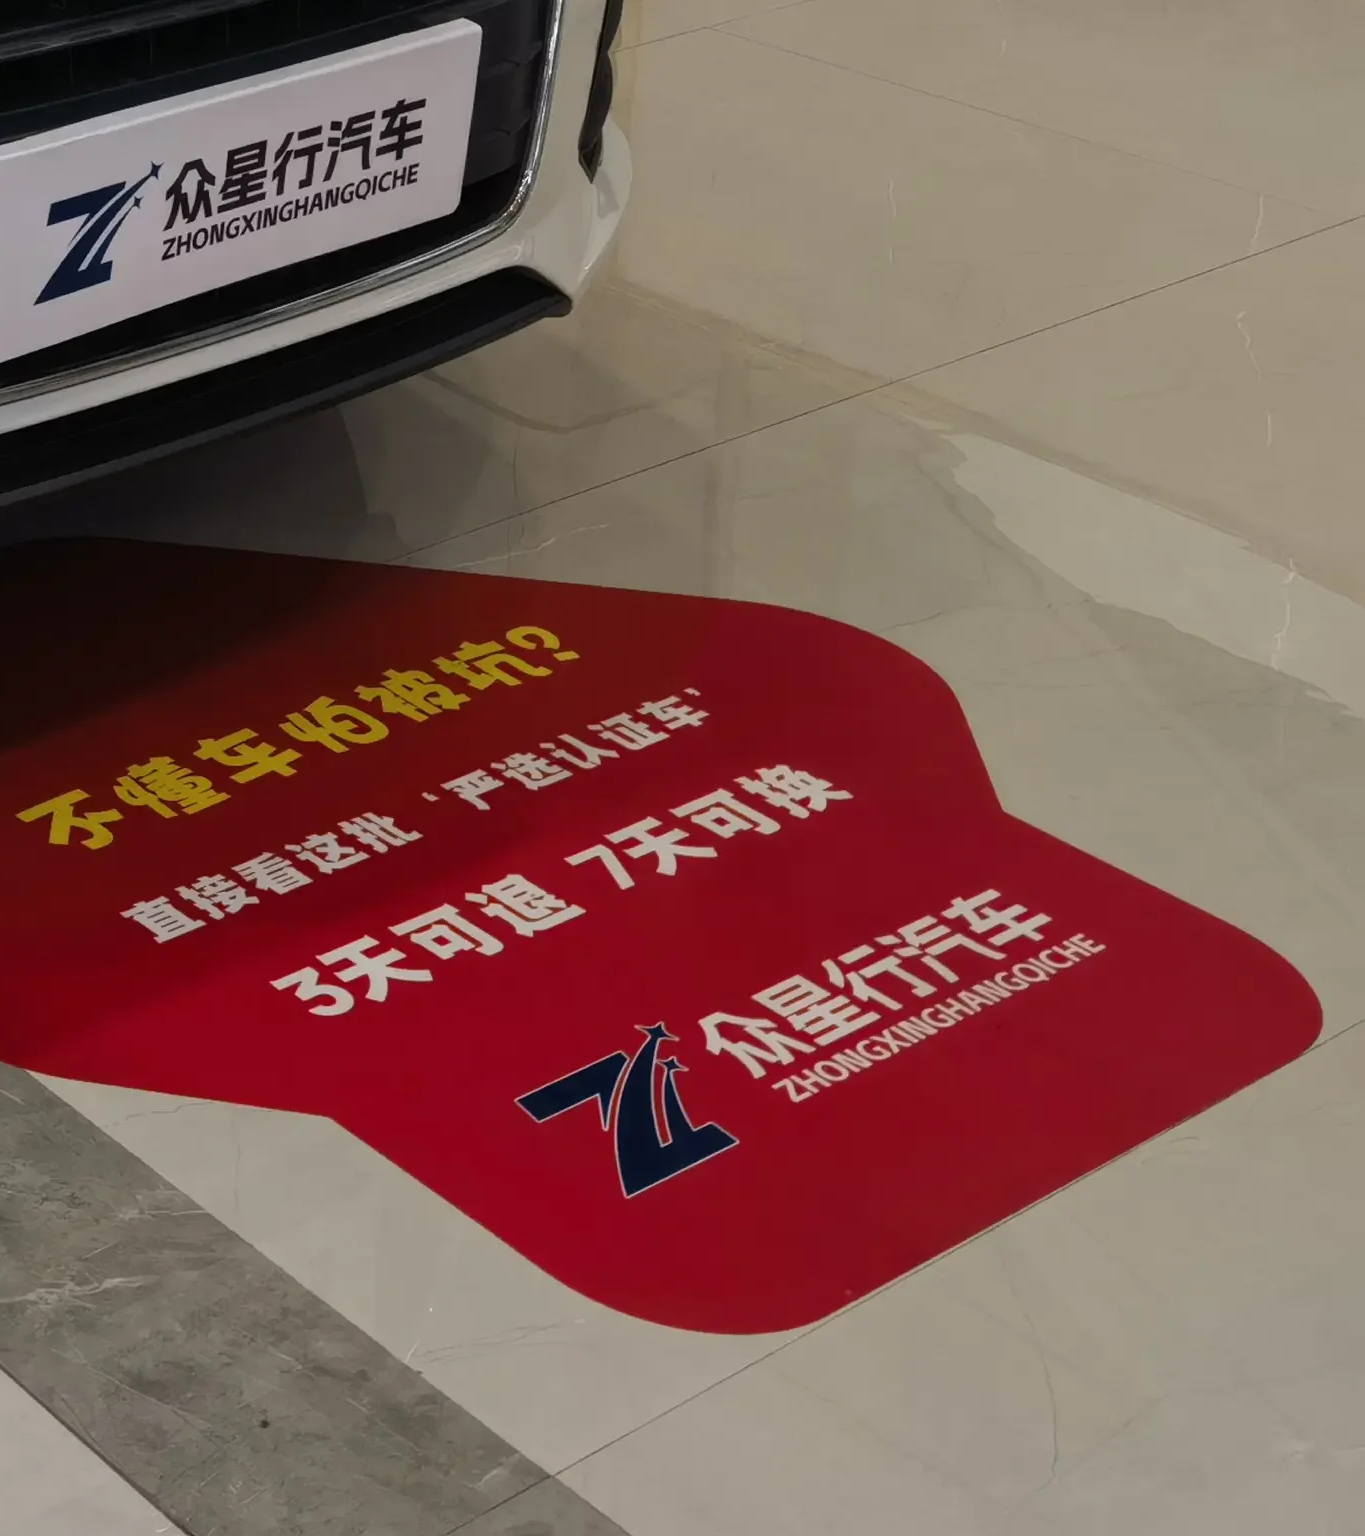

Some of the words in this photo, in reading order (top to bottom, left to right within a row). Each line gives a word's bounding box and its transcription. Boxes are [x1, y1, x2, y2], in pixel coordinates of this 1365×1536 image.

[161, 163, 420, 261] ZHONGXINGHANGQICHE
[163, 97, 427, 232] 众星行汽车
[17, 625, 580, 850] 不懂车怕被坑？
[270, 874, 585, 1017] 3天可退
[565, 764, 854, 891] 7天可换
[697, 888, 1052, 1079] 众星行汽车
[771, 933, 1106, 1103] ZHONGXINGHANGQICHE
